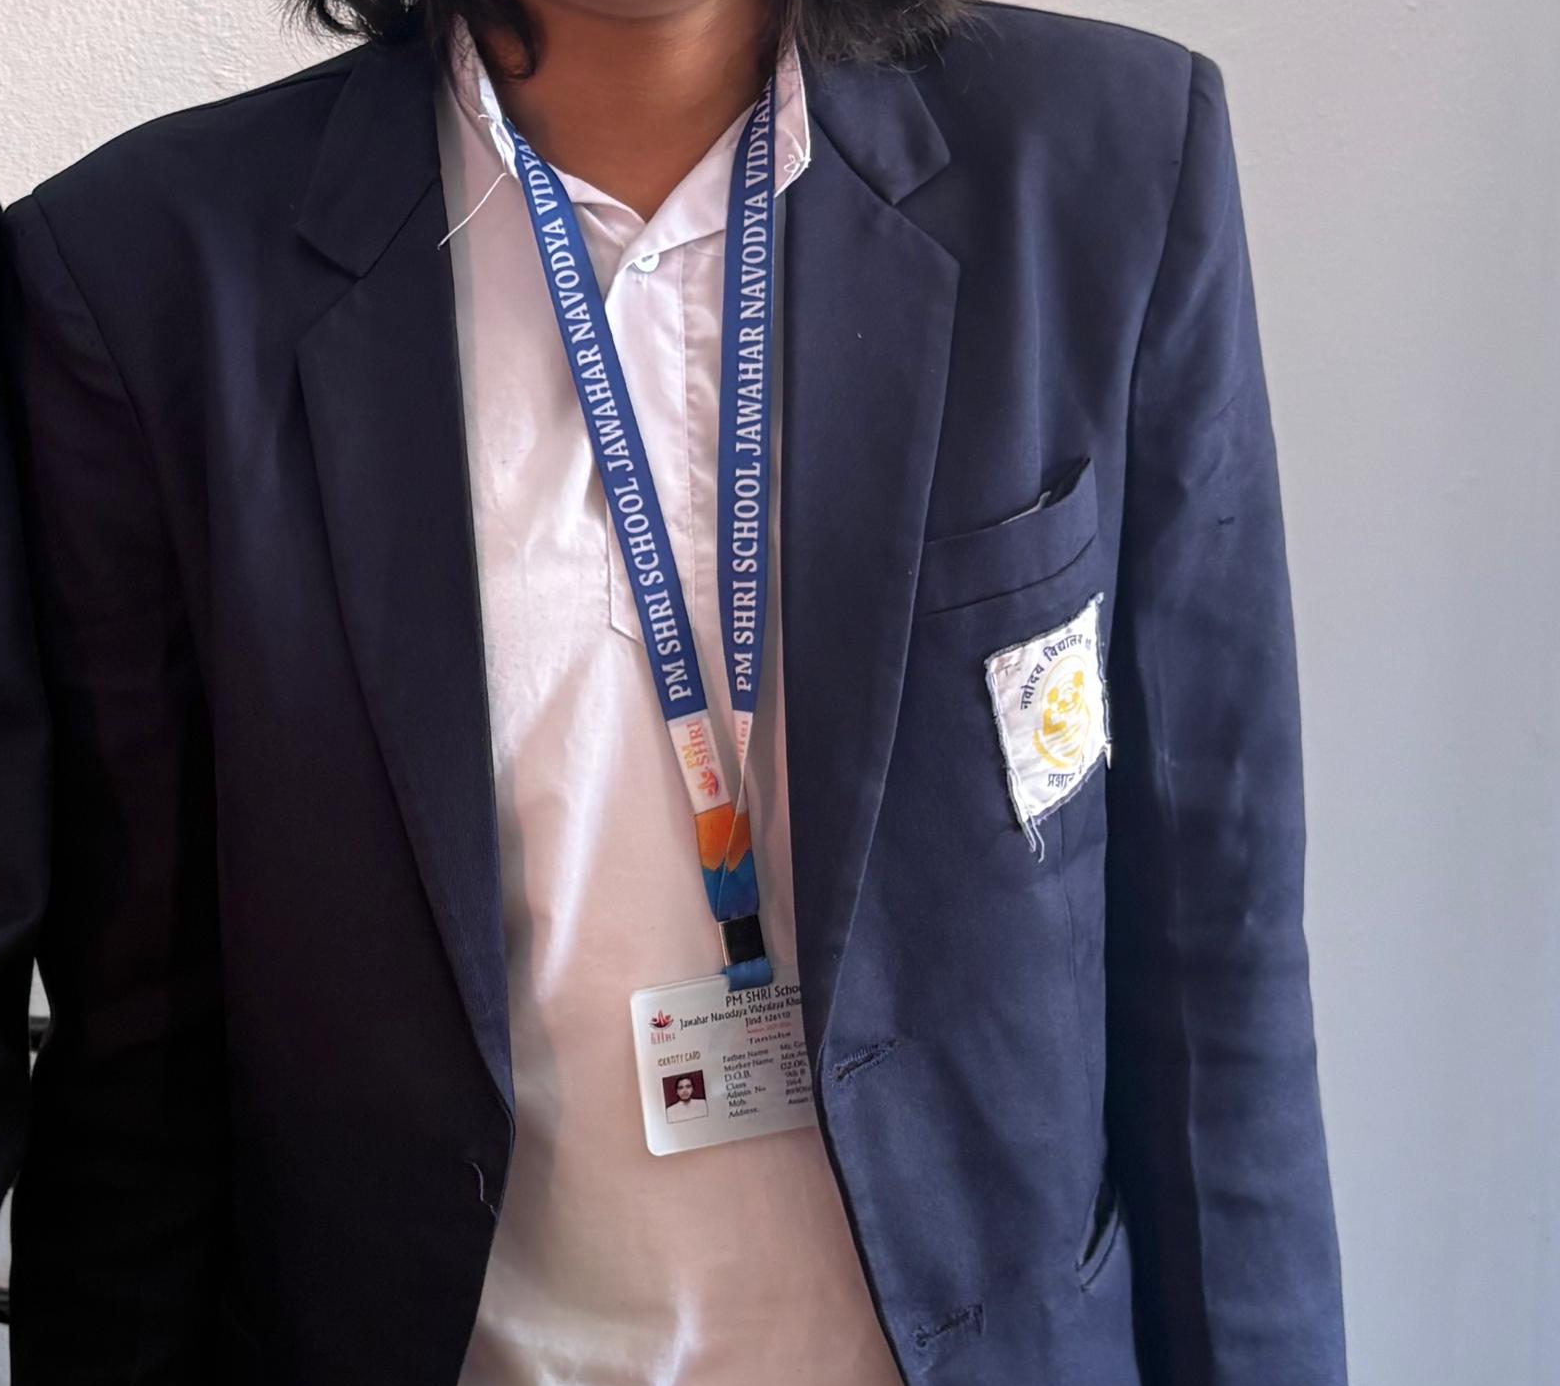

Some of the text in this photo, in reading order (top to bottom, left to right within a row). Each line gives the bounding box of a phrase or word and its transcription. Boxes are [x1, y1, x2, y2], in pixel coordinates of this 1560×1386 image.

[544, 218, 596, 343] NAVODYA
[739, 193, 768, 319] NAVODYA
[577, 344, 635, 473] JAWAHAR
[735, 323, 765, 457] JAWAHAR
[614, 476, 665, 587] SCHOOL
[733, 461, 762, 573] SCHOOL
[644, 589, 683, 656] SHRI
[733, 580, 757, 645] SHRI
[661, 659, 692, 702] PM
[736, 653, 752, 692] PM
[746, 987, 771, 1003] SHRI
